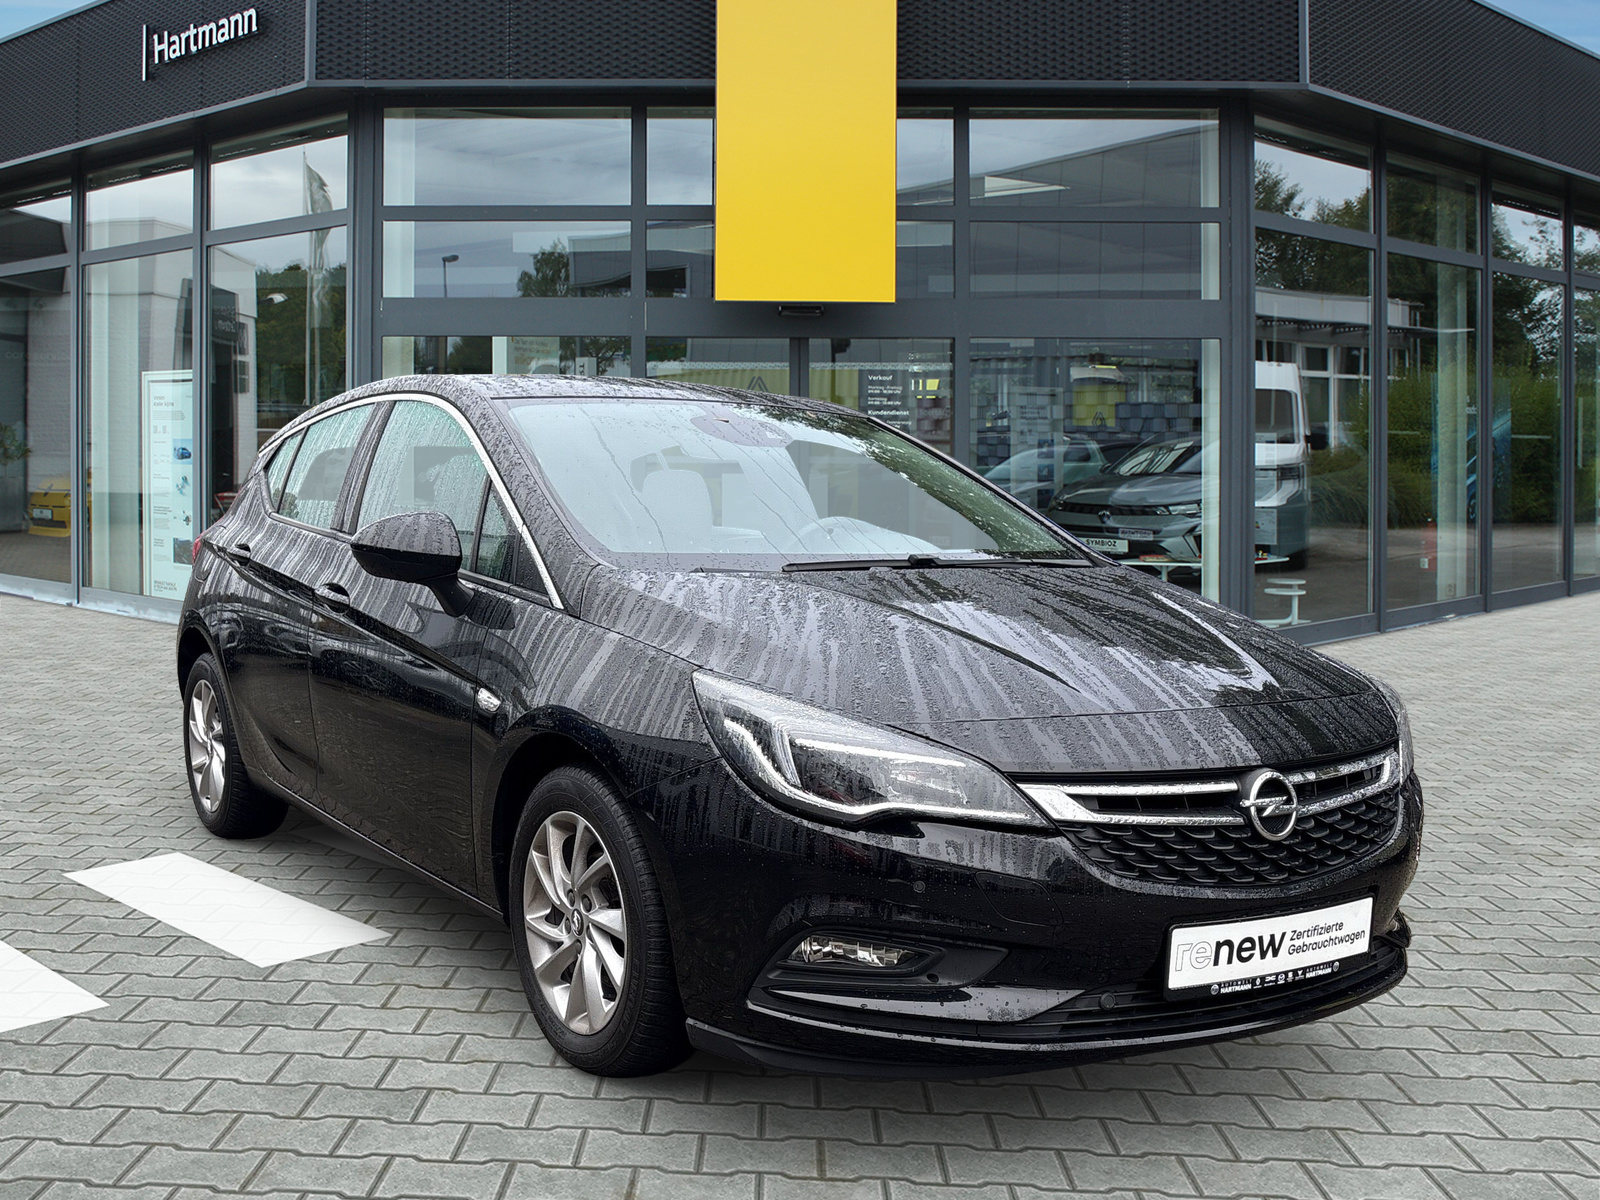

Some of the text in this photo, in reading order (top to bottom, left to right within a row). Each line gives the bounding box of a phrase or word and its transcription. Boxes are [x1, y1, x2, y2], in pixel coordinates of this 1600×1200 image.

[153, 8, 257, 65] Hartmann
[1085, 538, 1117, 547] SYMBIOZ
[1290, 921, 1344, 941] Zertifizierte
[1175, 932, 1286, 972] renew
[1288, 929, 1366, 956] Gebrauchtwagen
[1306, 967, 1332, 978] HARTMANN
[1220, 984, 1252, 994] HARTMANN
